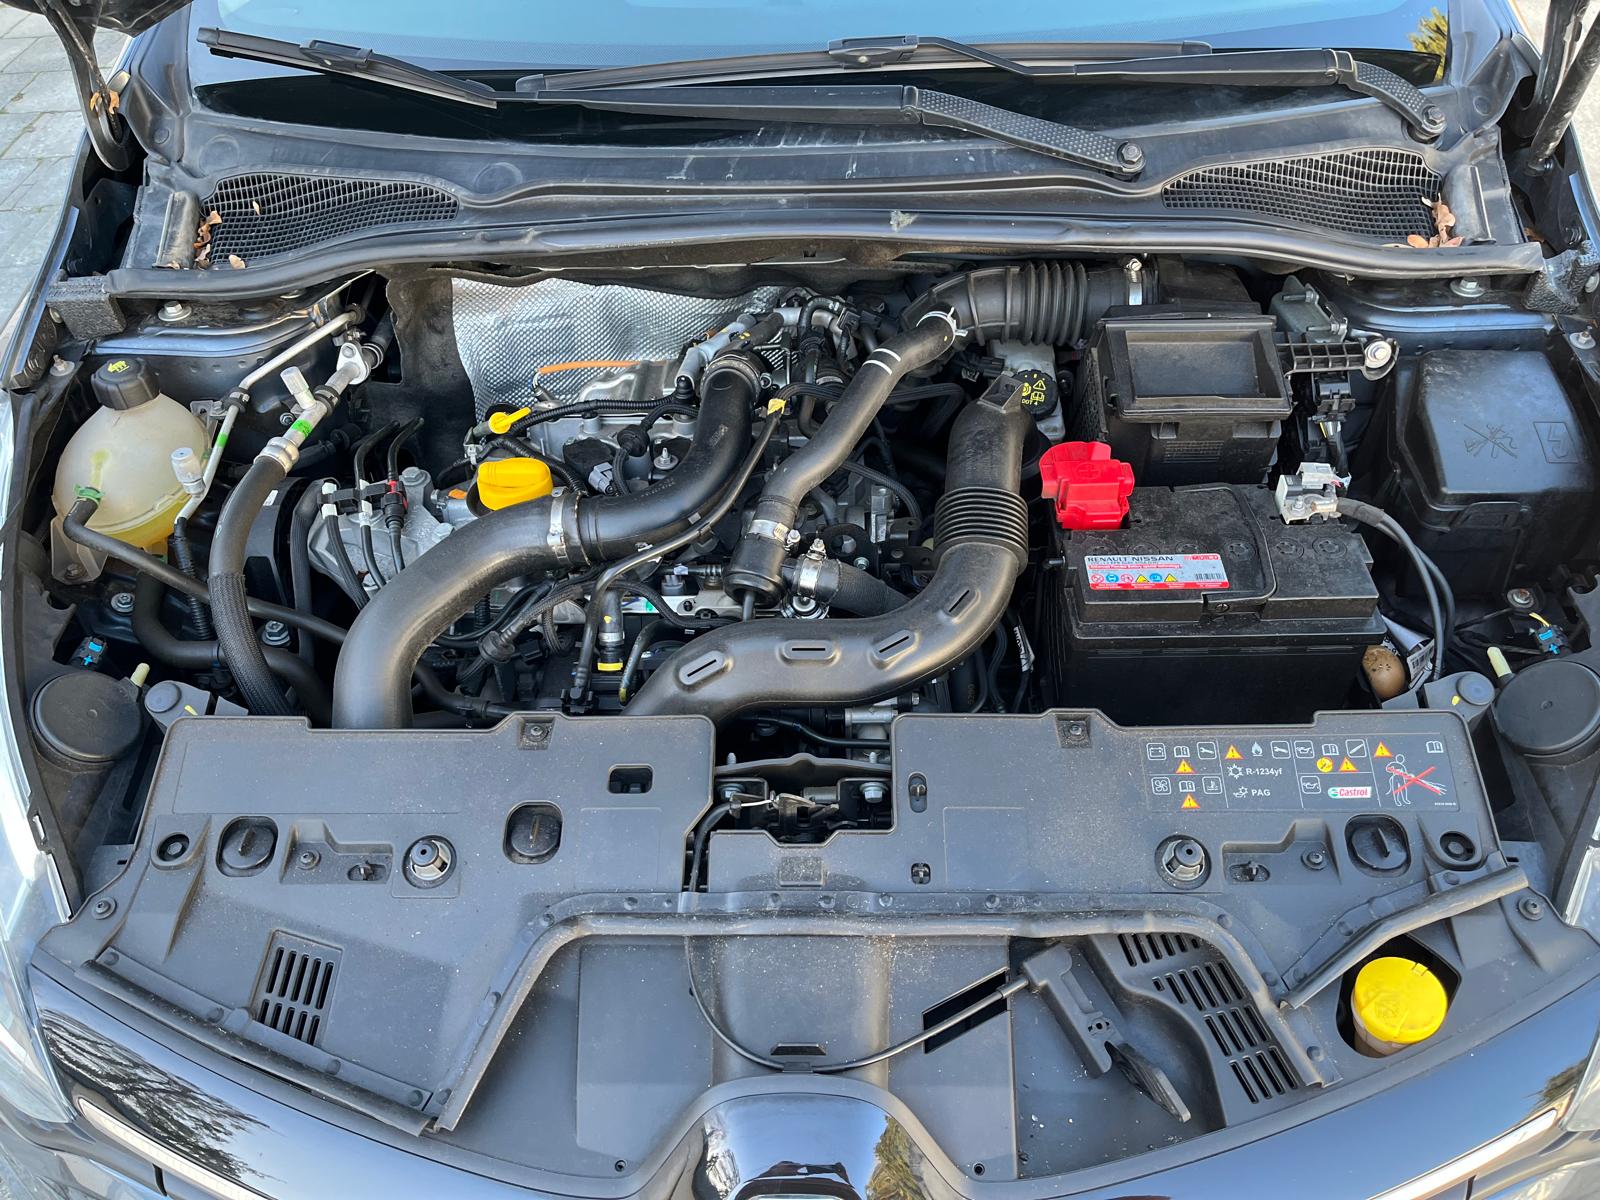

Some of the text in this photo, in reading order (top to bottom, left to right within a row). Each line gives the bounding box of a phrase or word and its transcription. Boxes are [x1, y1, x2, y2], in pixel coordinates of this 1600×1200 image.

[1245, 767, 1283, 777] R-1234yf
[1251, 788, 1271, 797] PAG
[1339, 788, 1369, 797] Castrol
